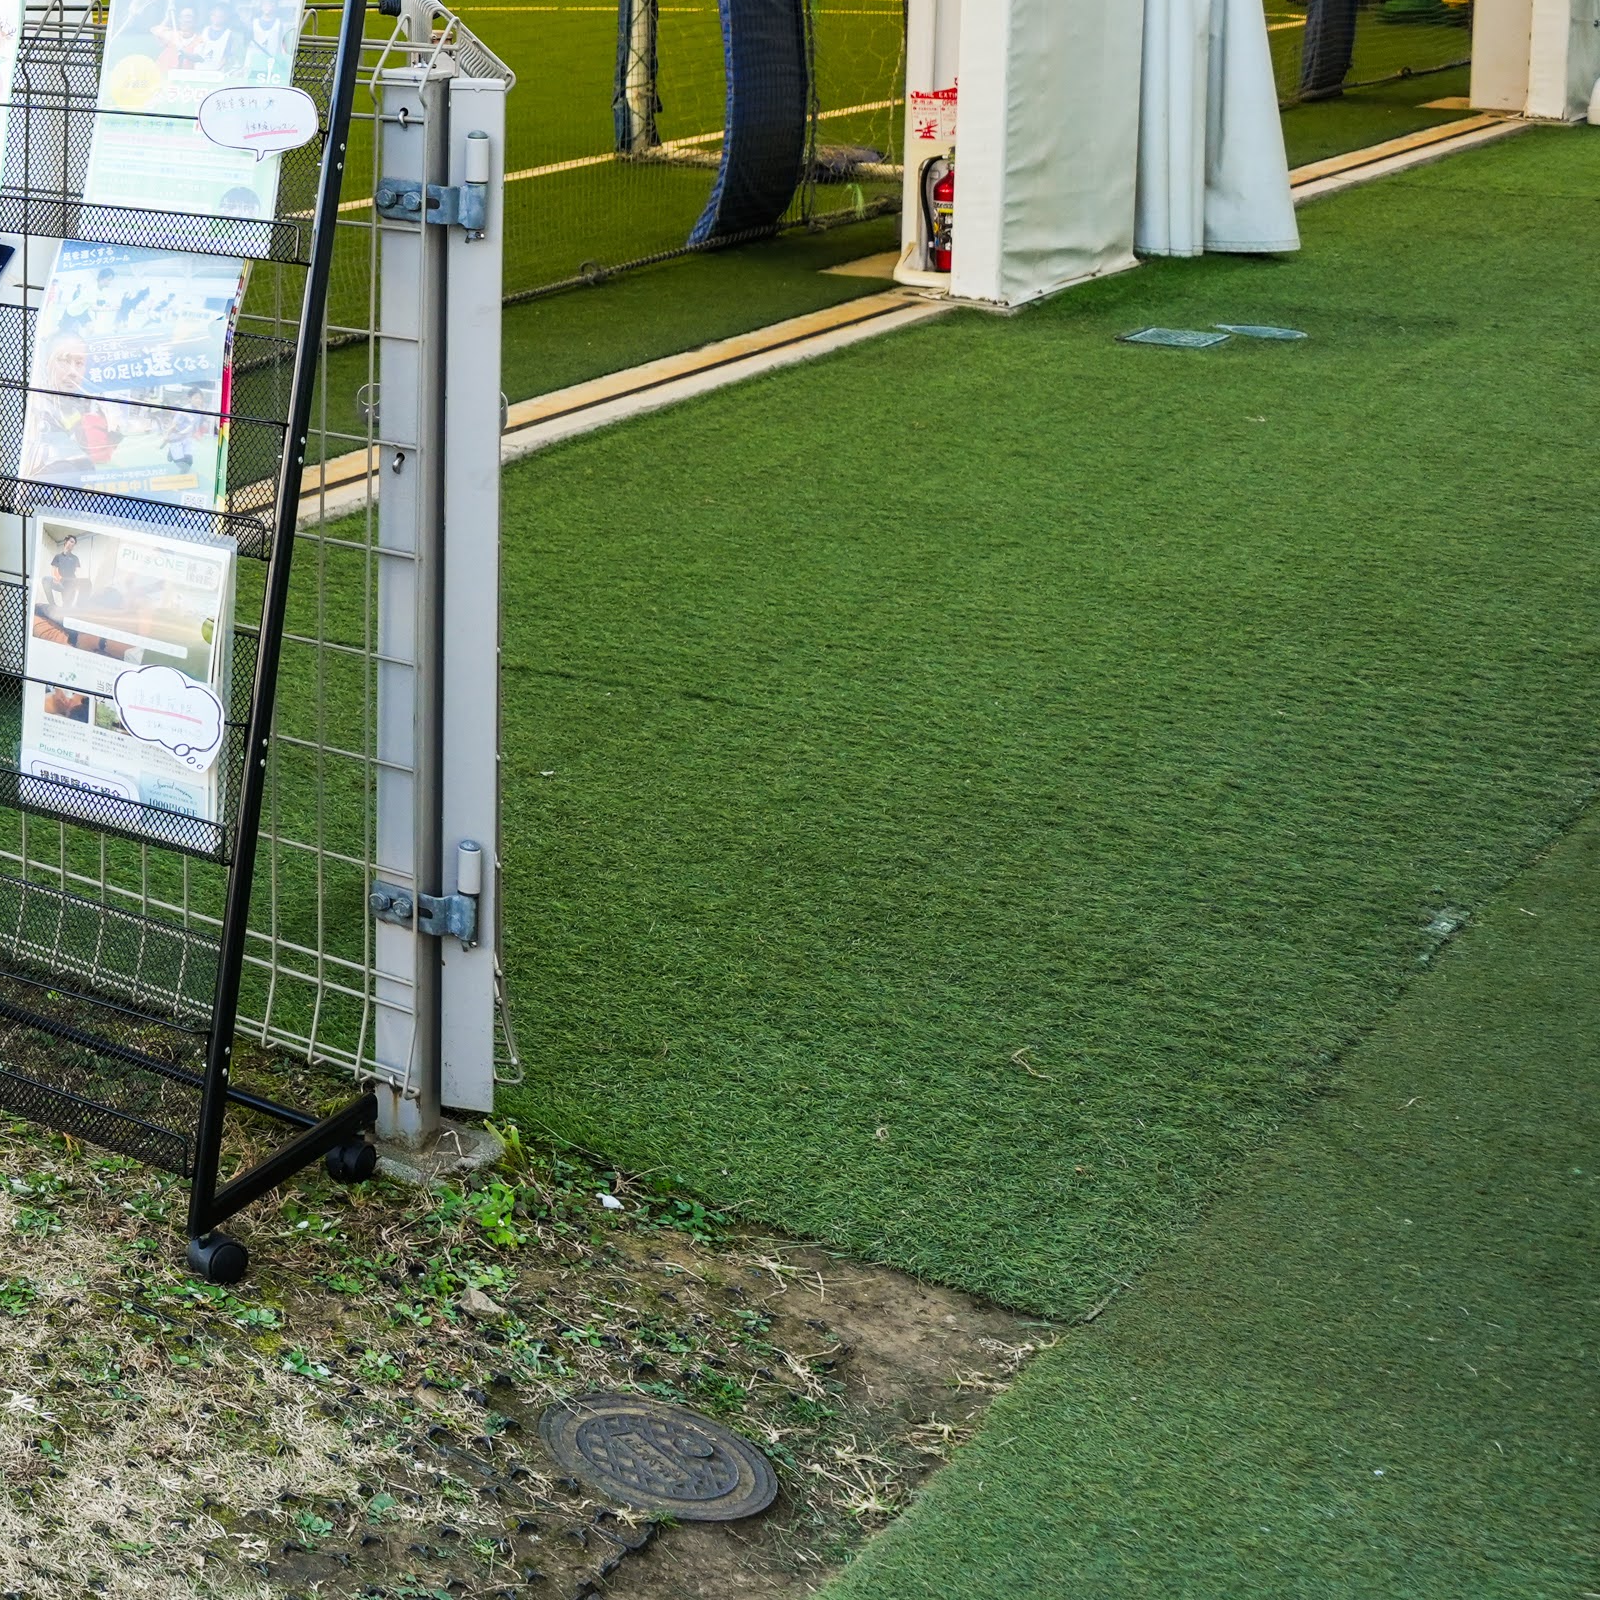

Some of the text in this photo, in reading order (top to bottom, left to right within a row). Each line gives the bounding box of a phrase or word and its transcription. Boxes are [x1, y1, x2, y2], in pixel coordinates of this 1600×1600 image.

[62, 246, 115, 262] 足を速くする
[62, 255, 131, 270] トレーニングスクール
[89, 345, 216, 384] 君の足は速くなる。
